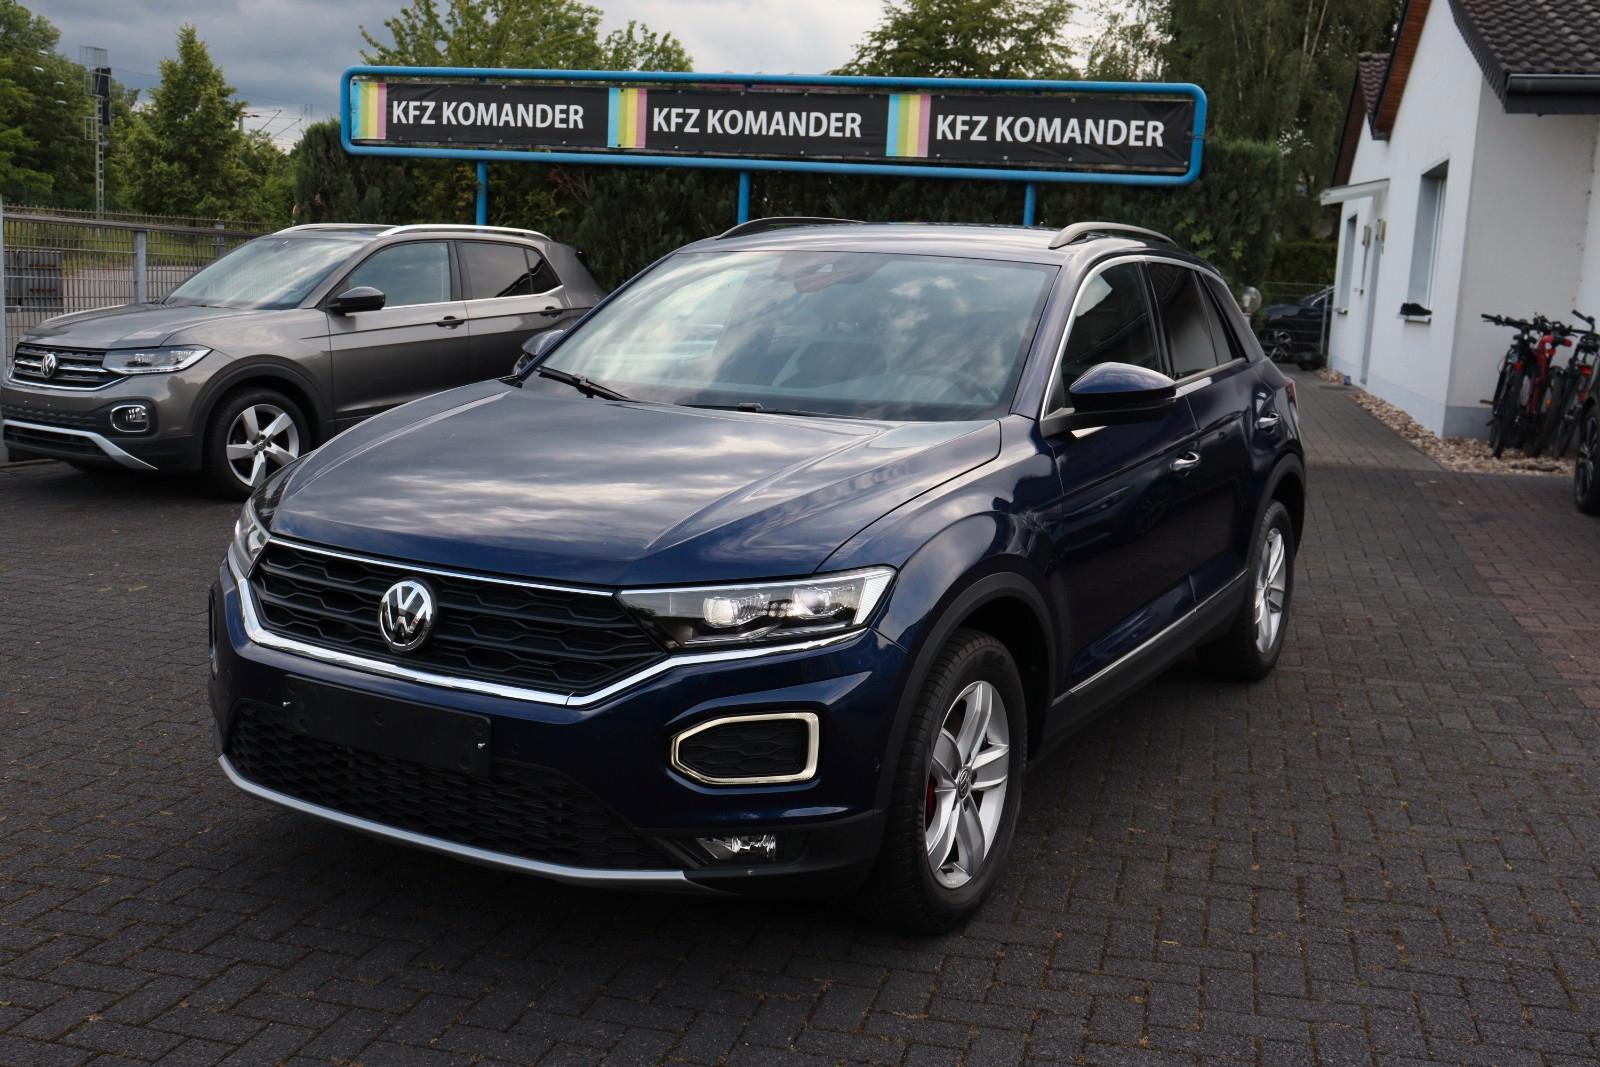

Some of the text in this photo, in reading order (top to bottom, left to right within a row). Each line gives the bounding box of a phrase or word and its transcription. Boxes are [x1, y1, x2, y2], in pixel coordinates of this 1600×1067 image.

[392, 100, 584, 130] KFZ KOMANDER
[652, 107, 862, 139] KFZ KOMANDER
[936, 114, 1164, 148] KFZ KOMANDER
[379, 580, 433, 650] VW
